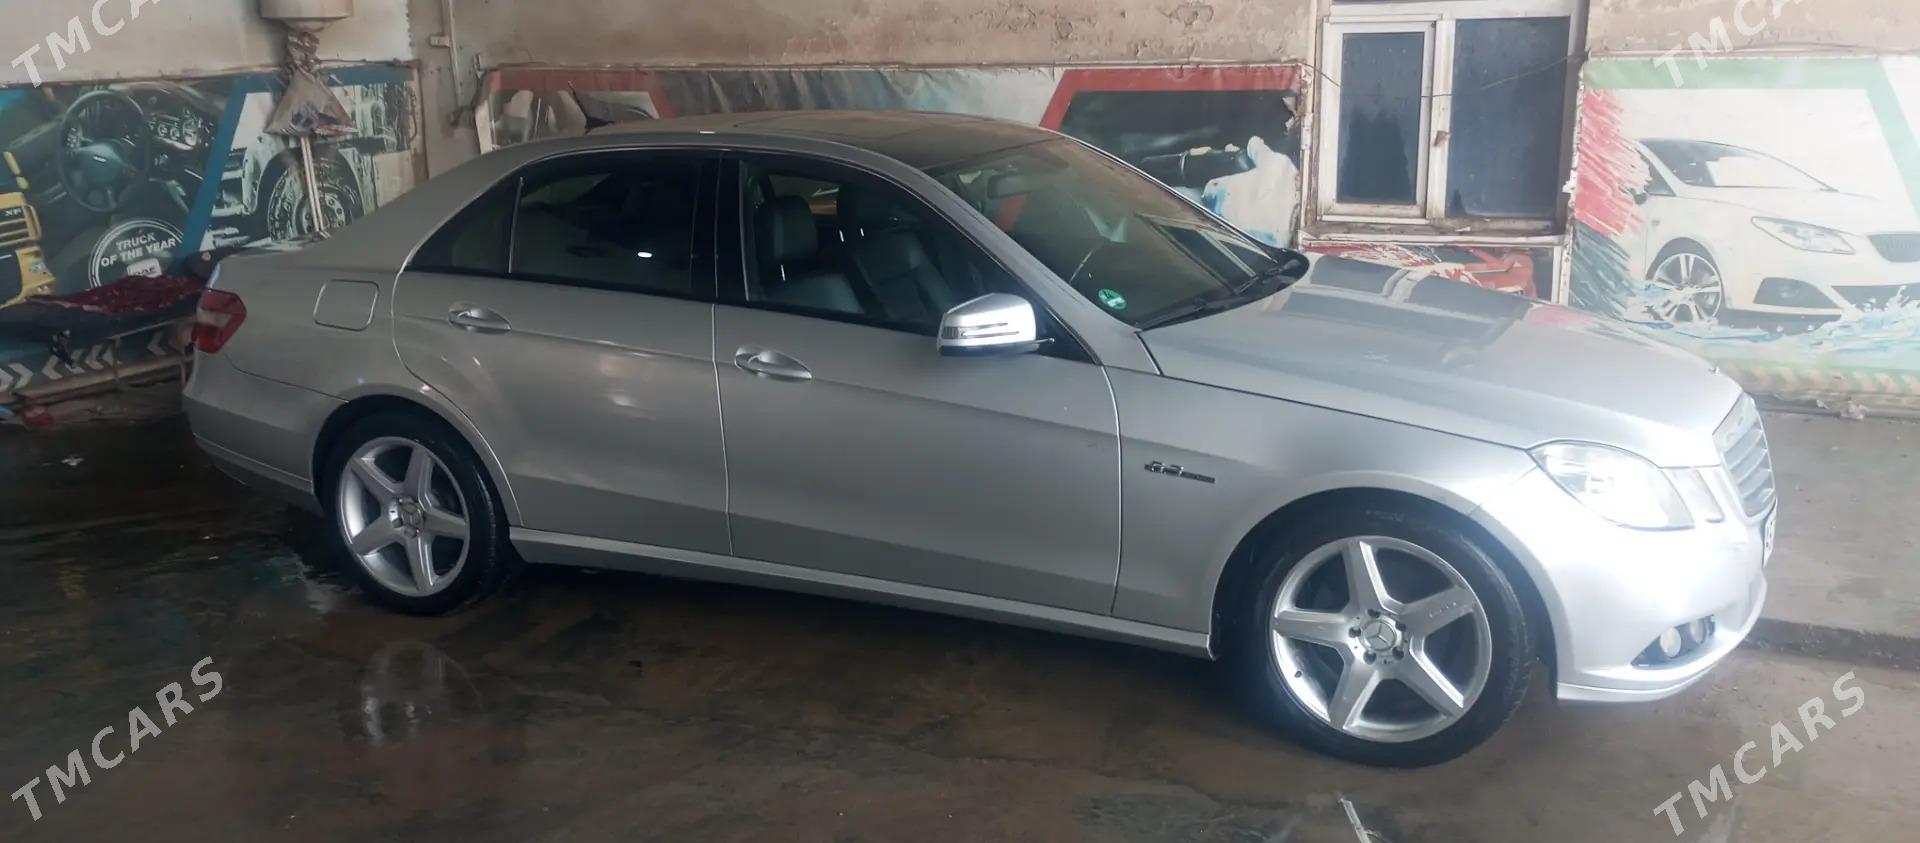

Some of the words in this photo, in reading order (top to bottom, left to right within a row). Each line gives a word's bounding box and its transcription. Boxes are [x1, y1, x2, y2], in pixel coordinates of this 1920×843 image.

[101, 254, 118, 267] OF
[120, 247, 143, 262] THE
[146, 238, 176, 254] YEAR
[116, 232, 155, 251] TRUCK
